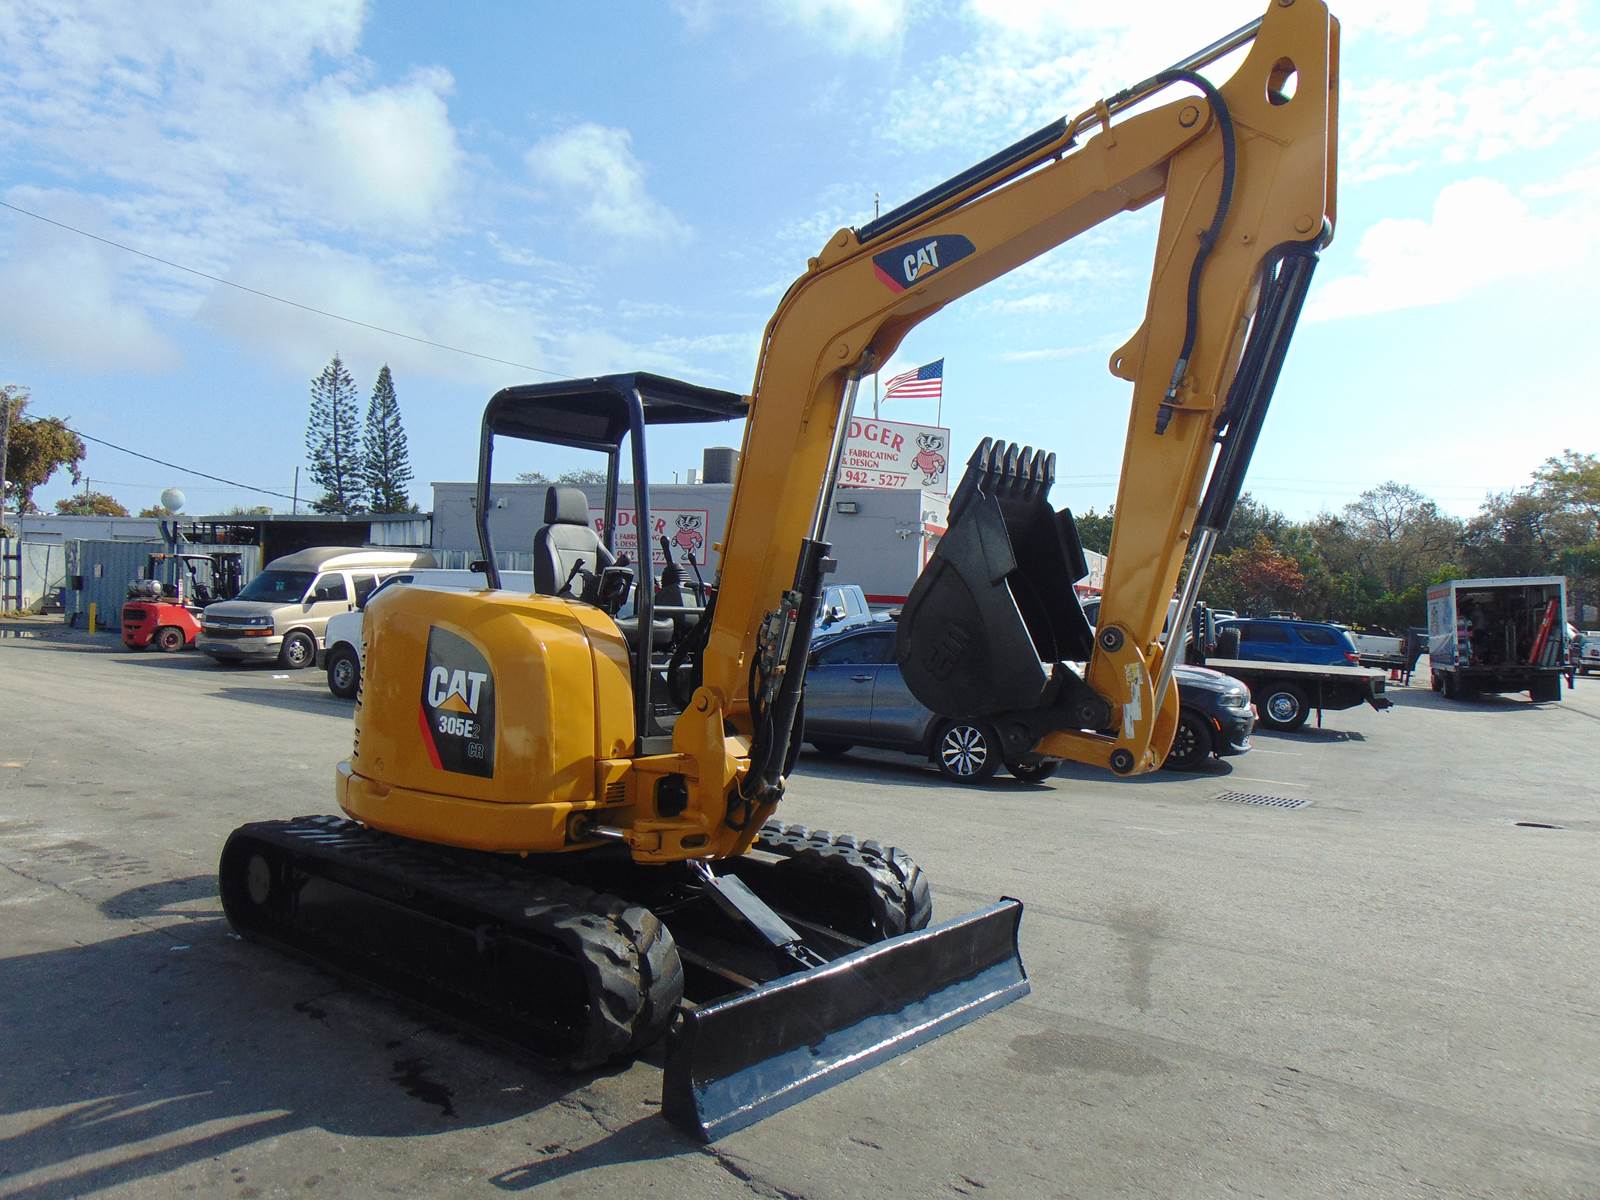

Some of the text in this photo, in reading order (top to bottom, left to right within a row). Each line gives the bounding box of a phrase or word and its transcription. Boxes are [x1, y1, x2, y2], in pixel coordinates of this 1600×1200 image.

[903, 240, 939, 282] CAT
[848, 449, 898, 461] FABRICATING
[850, 458, 879, 468] DESIGN
[845, 470, 868, 484] 942
[878, 474, 908, 487] 5277
[428, 666, 487, 714] CAT
[468, 742, 484, 759] CR
